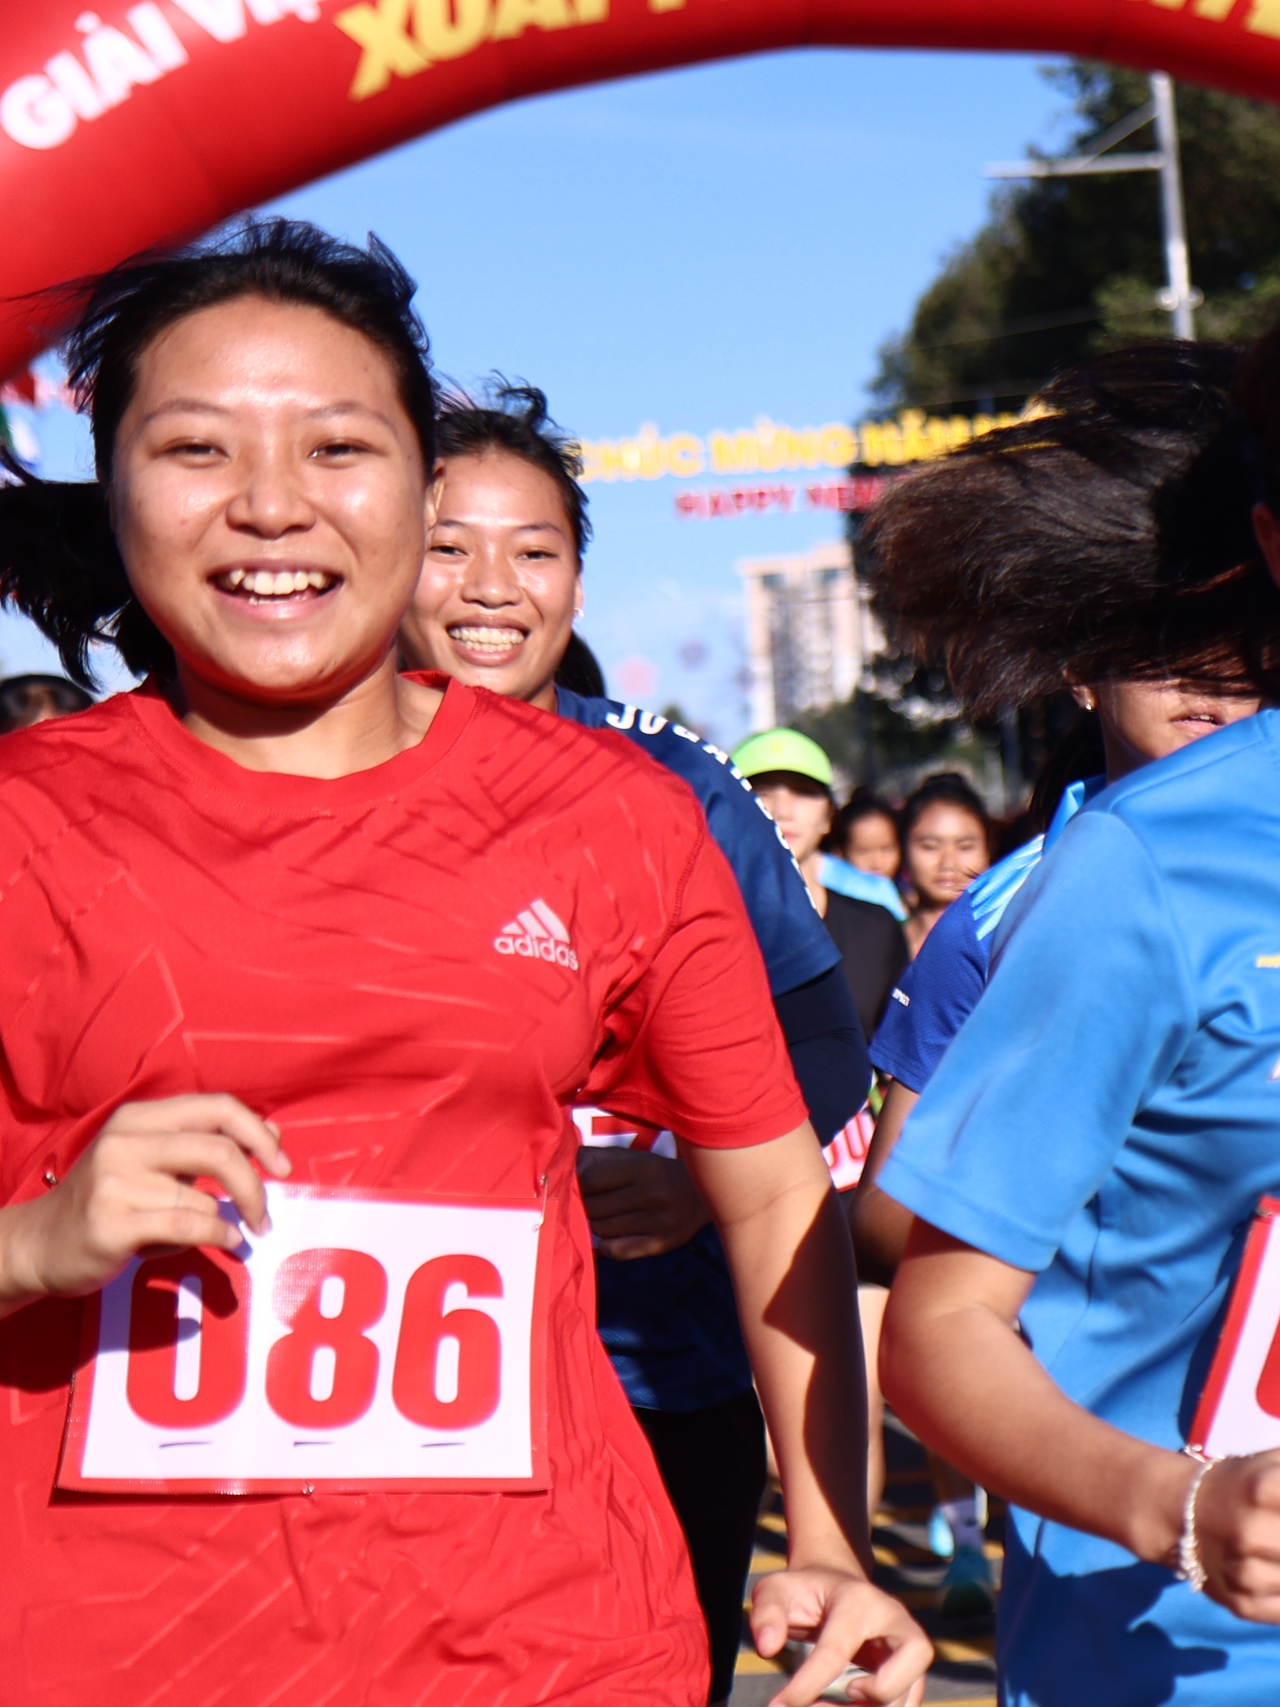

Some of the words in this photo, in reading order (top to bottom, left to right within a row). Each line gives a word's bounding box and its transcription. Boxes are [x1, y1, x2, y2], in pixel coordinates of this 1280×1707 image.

[676, 485, 795, 520] HAPPY
[494, 935, 580, 971] adidas
[126, 1247, 504, 1431] 086
